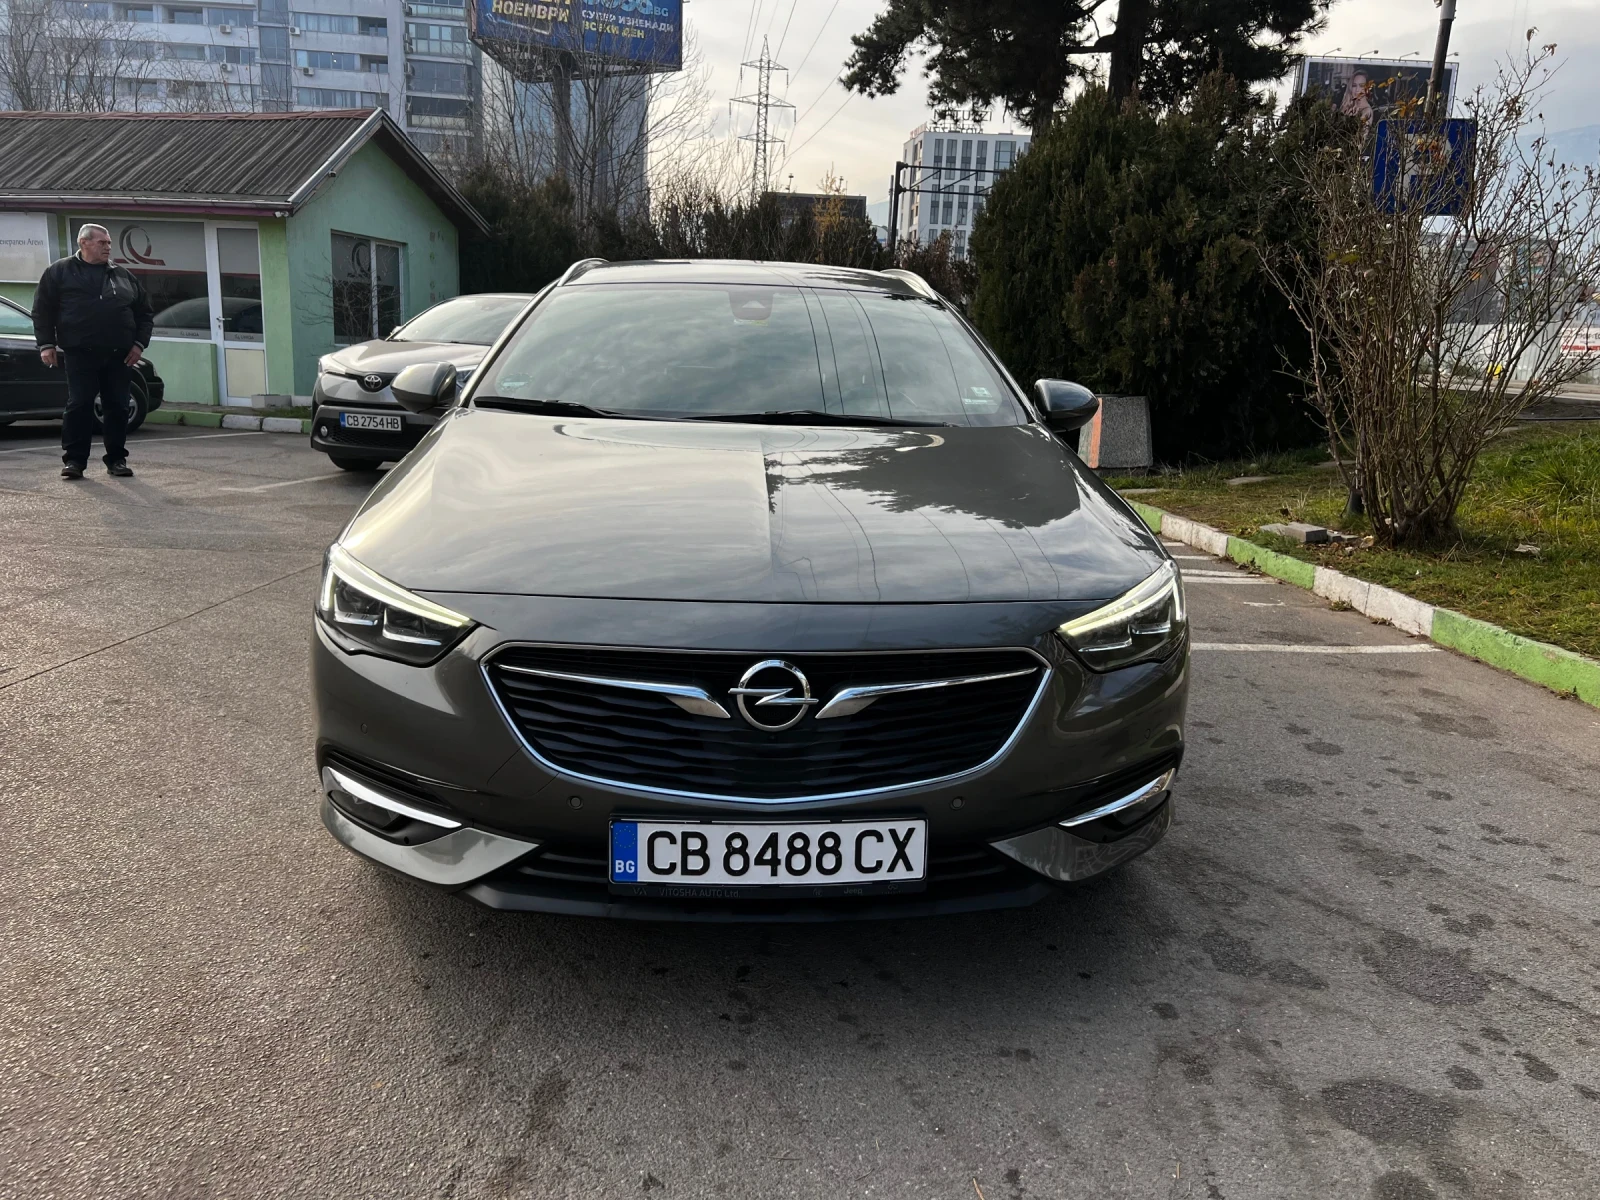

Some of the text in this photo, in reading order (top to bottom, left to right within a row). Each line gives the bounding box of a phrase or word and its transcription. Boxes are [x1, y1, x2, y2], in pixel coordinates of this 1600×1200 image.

[492, 0, 570, 22] НОЕМВРИ
[360, 415, 384, 429] 2754
[615, 827, 916, 877] BG CB 8488 CX
[659, 887, 698, 897] VITOSHA
[699, 888, 723, 898] AUTO
[843, 886, 863, 896] Jeep
